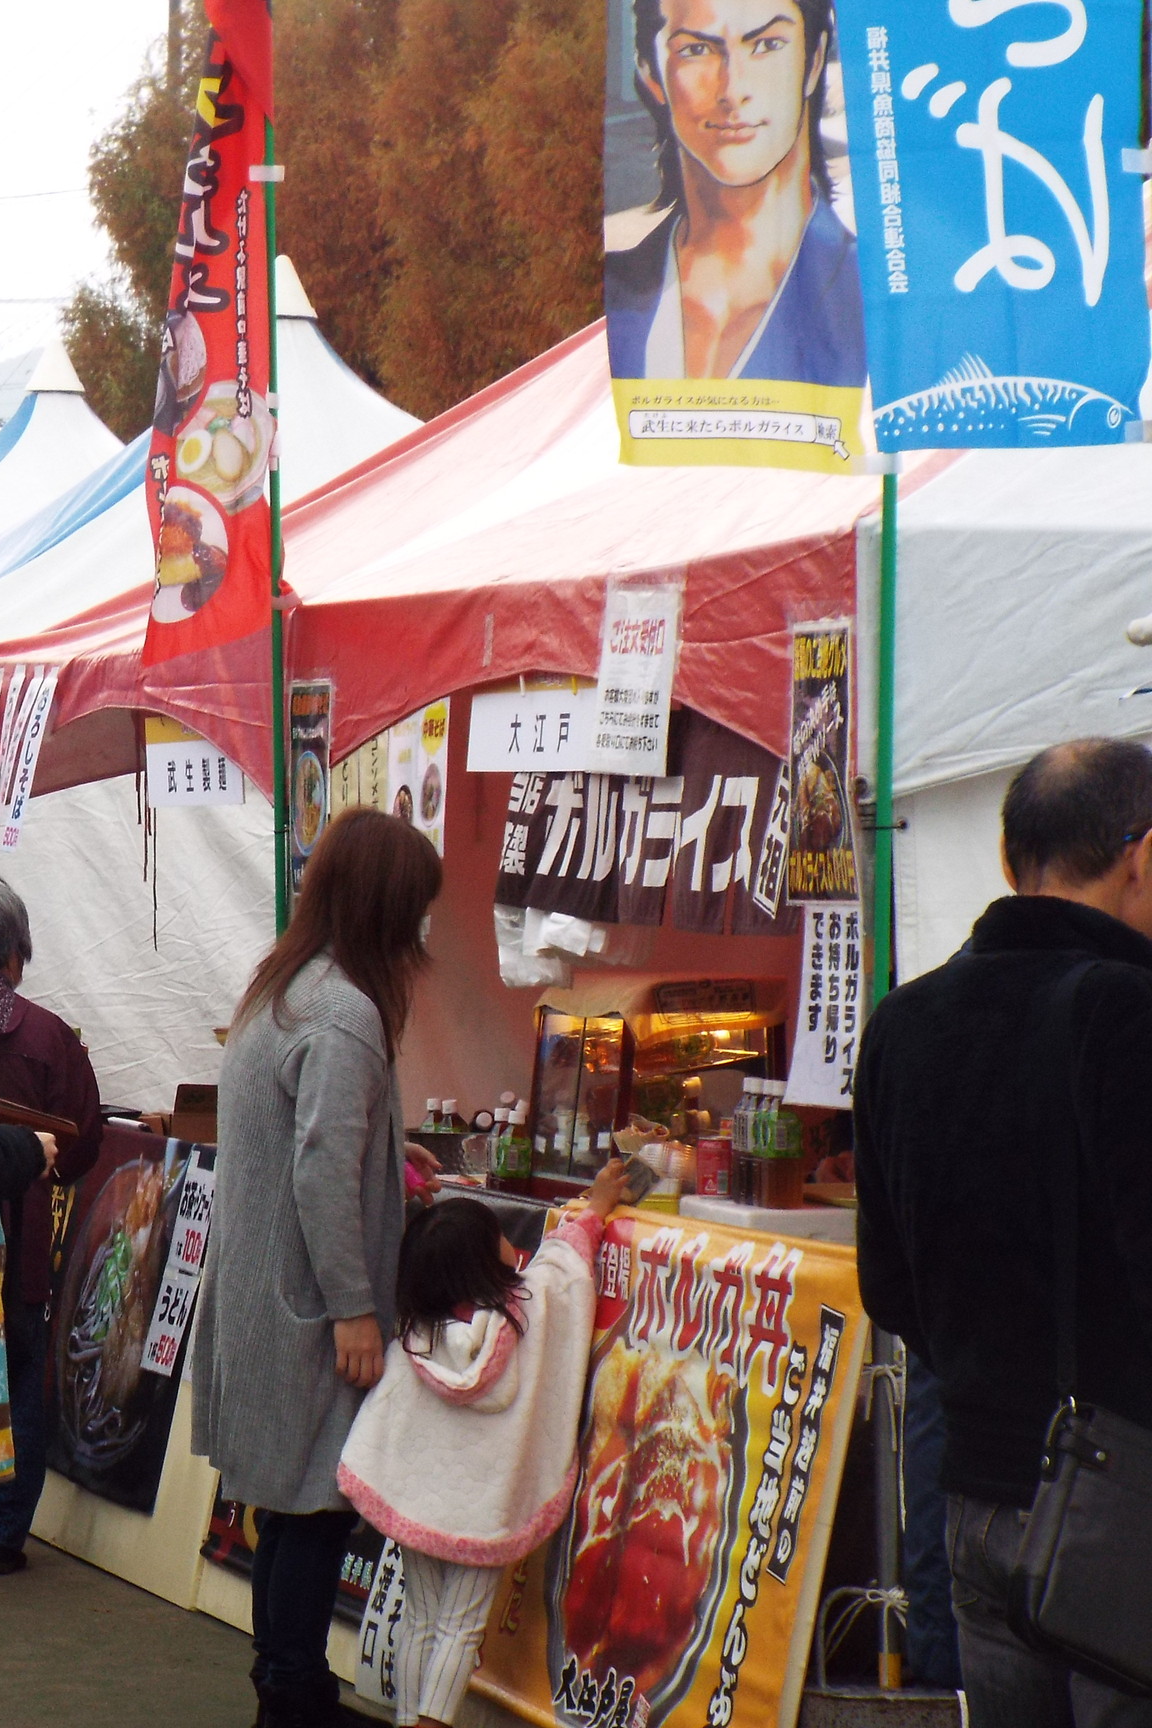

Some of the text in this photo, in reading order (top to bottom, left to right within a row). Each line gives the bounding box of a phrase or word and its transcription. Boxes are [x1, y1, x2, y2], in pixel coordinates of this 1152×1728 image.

[641, 417, 805, 437] 武生に来たらボルガライス
[817, 421, 837, 441] 検索
[508, 712, 571, 753] 大江戸
[536, 772, 760, 893] ボルガライス
[758, 762, 790, 903] 元祖
[808, 911, 824, 1032] できます
[824, 910, 842, 1064] お持ち帰り
[840, 910, 860, 1096] ボルガライス
[159, 1285, 189, 1328] うどん
